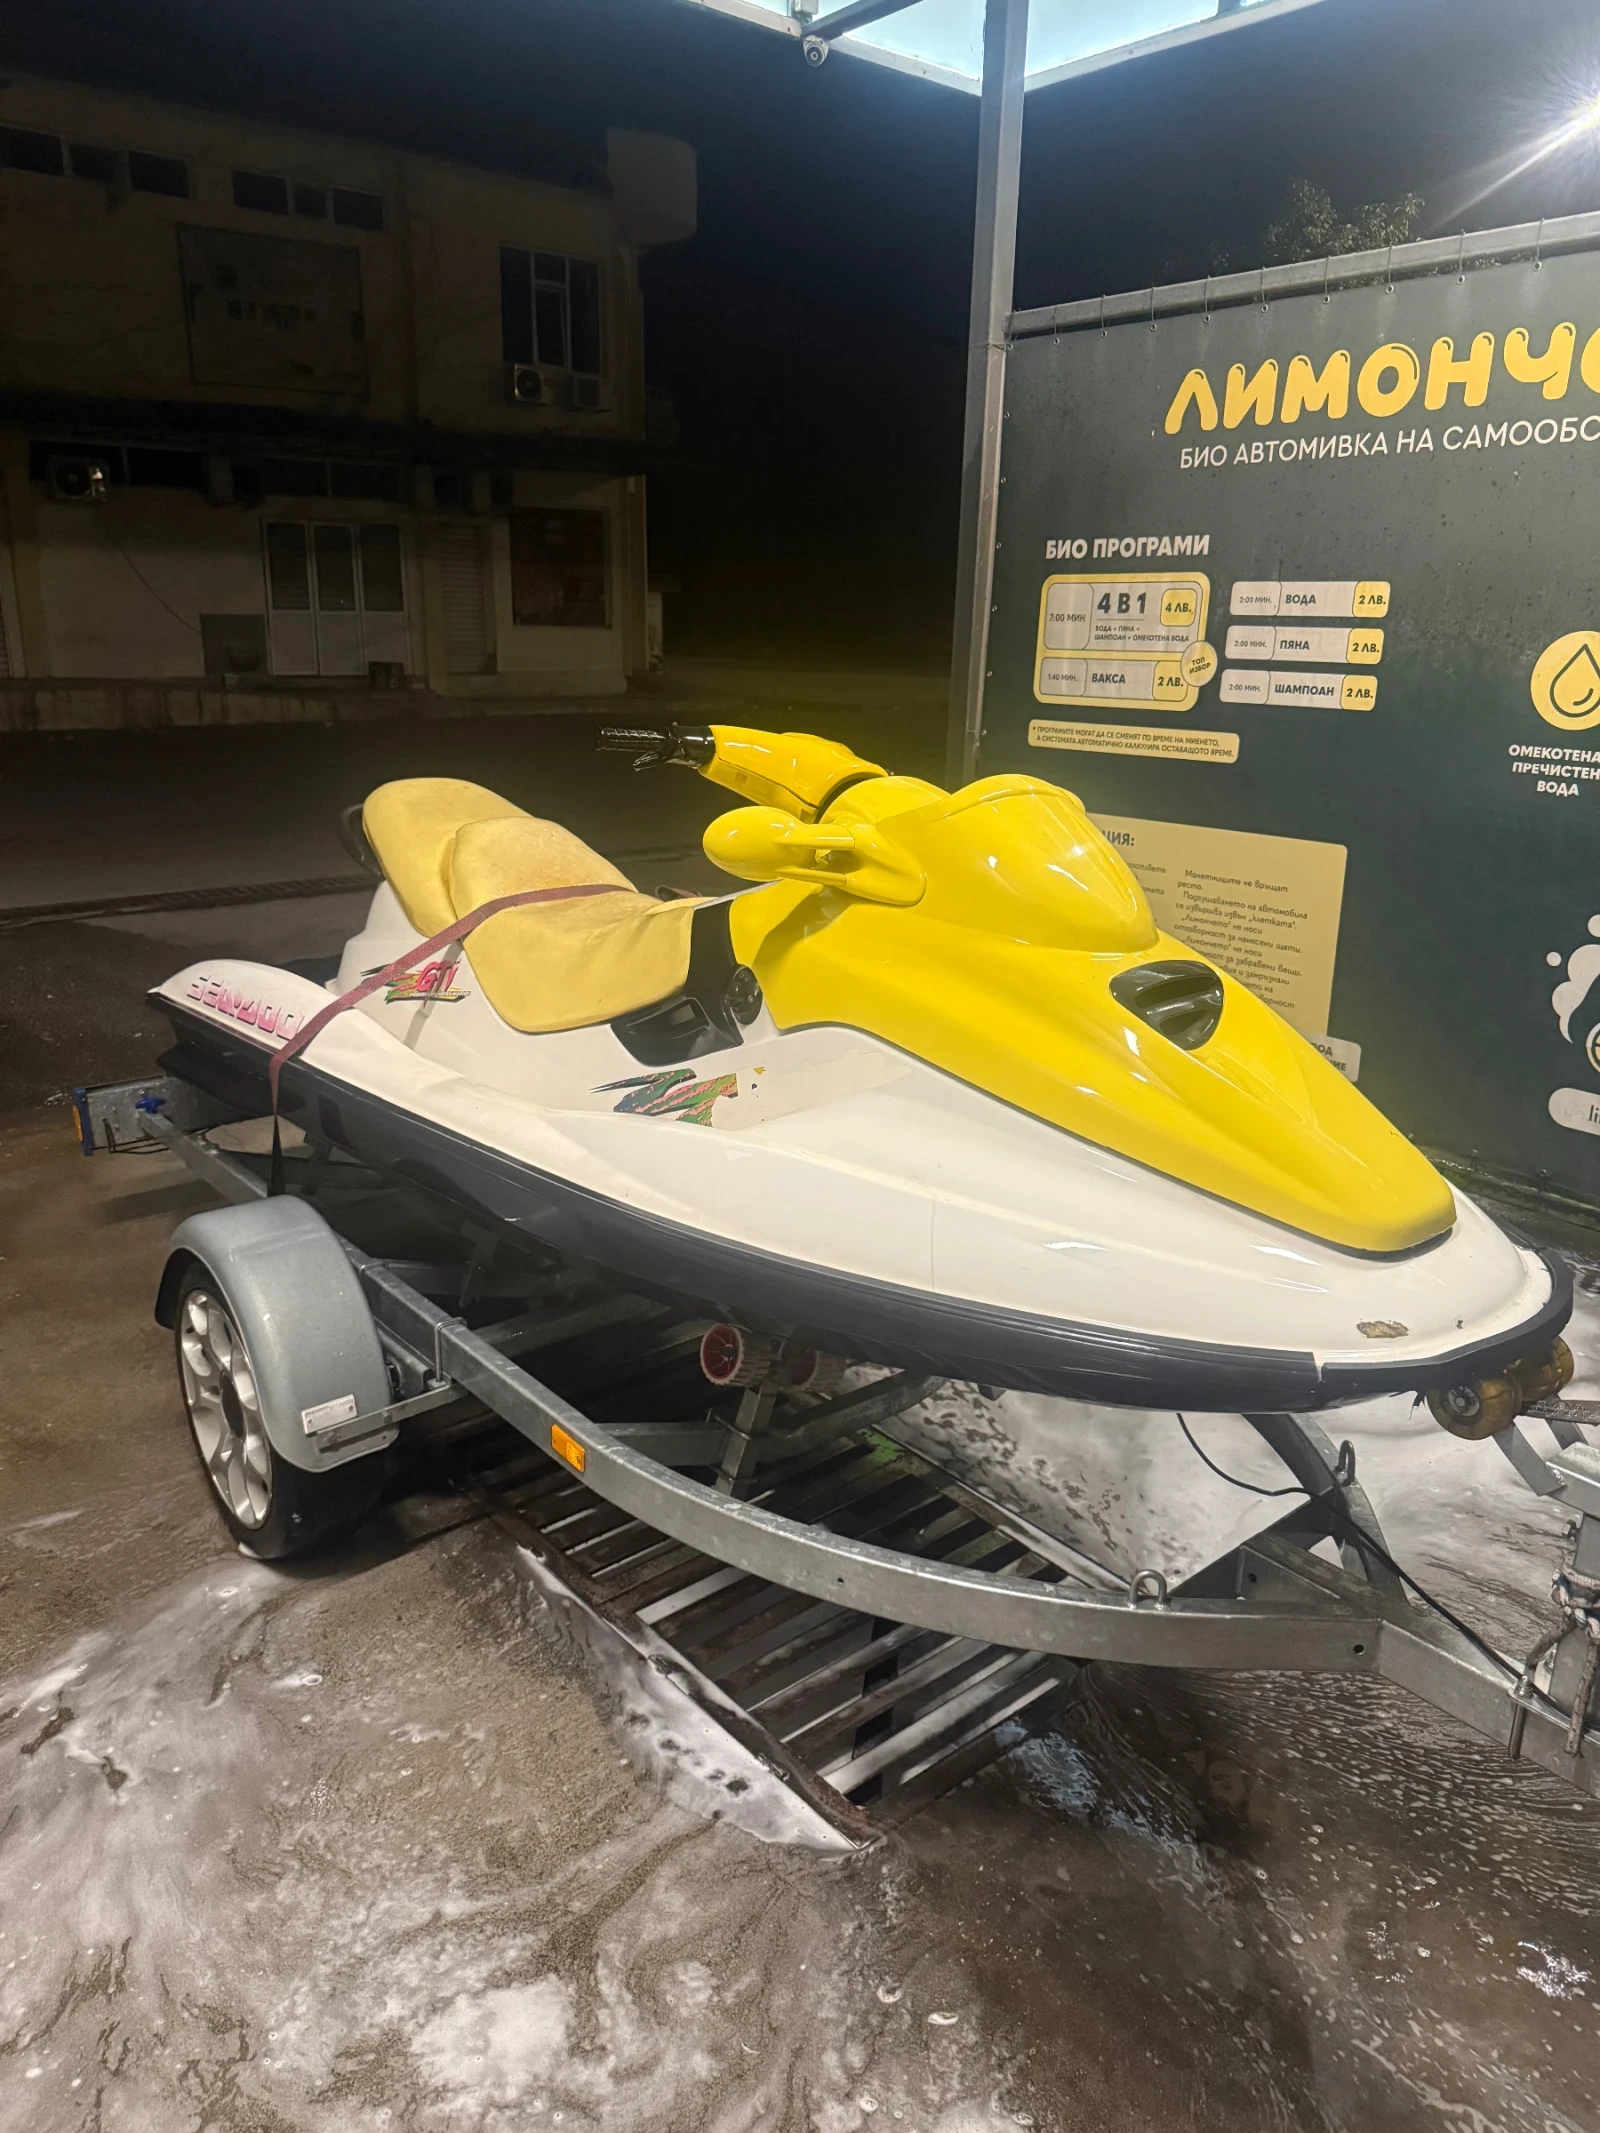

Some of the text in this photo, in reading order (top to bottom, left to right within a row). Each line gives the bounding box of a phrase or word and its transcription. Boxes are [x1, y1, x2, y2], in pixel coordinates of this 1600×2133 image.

[1180, 445, 1227, 470] БИО
[1233, 431, 1388, 465] АВТОМИВКА
[1396, 425, 1434, 453] НА
[1045, 534, 1210, 559] БИО ПРОГРАМИ
[1097, 592, 1147, 614] 4 В 1
[1239, 596, 1254, 604] 2:00
[1285, 594, 1316, 606] ВОДА
[1358, 595, 1365, 605] 2
[1367, 595, 1386, 605] ЛВ.
[1165, 603, 1192, 613] 4 ЛВ.
[1049, 613, 1065, 622] 7:00
[1234, 640, 1249, 648] 2:00
[1280, 640, 1310, 650] ПЯНА
[1352, 643, 1359, 652] 2
[1361, 643, 1380, 653] ЛВ.
[1192, 656, 1206, 666] ТОП
[1091, 673, 1126, 684] ВАКСА
[1157, 676, 1164, 687] 2
[1165, 676, 1184, 687] ЛВ.
[1274, 684, 1334, 696] ШАМПОАН
[1346, 688, 1353, 698] 2
[1354, 689, 1373, 699] ЛВ.
[1075, 729, 1095, 737] МОГАТ
[1153, 735, 1173, 743] ВРЕМЕ
[1042, 735, 1076, 744] СИСТЕМАТА
[1078, 738, 1123, 748] АВТОМАТИЧНО
[1161, 745, 1209, 755] ОСТАВАЩОТО
[1536, 780, 1579, 797] ВОДА
